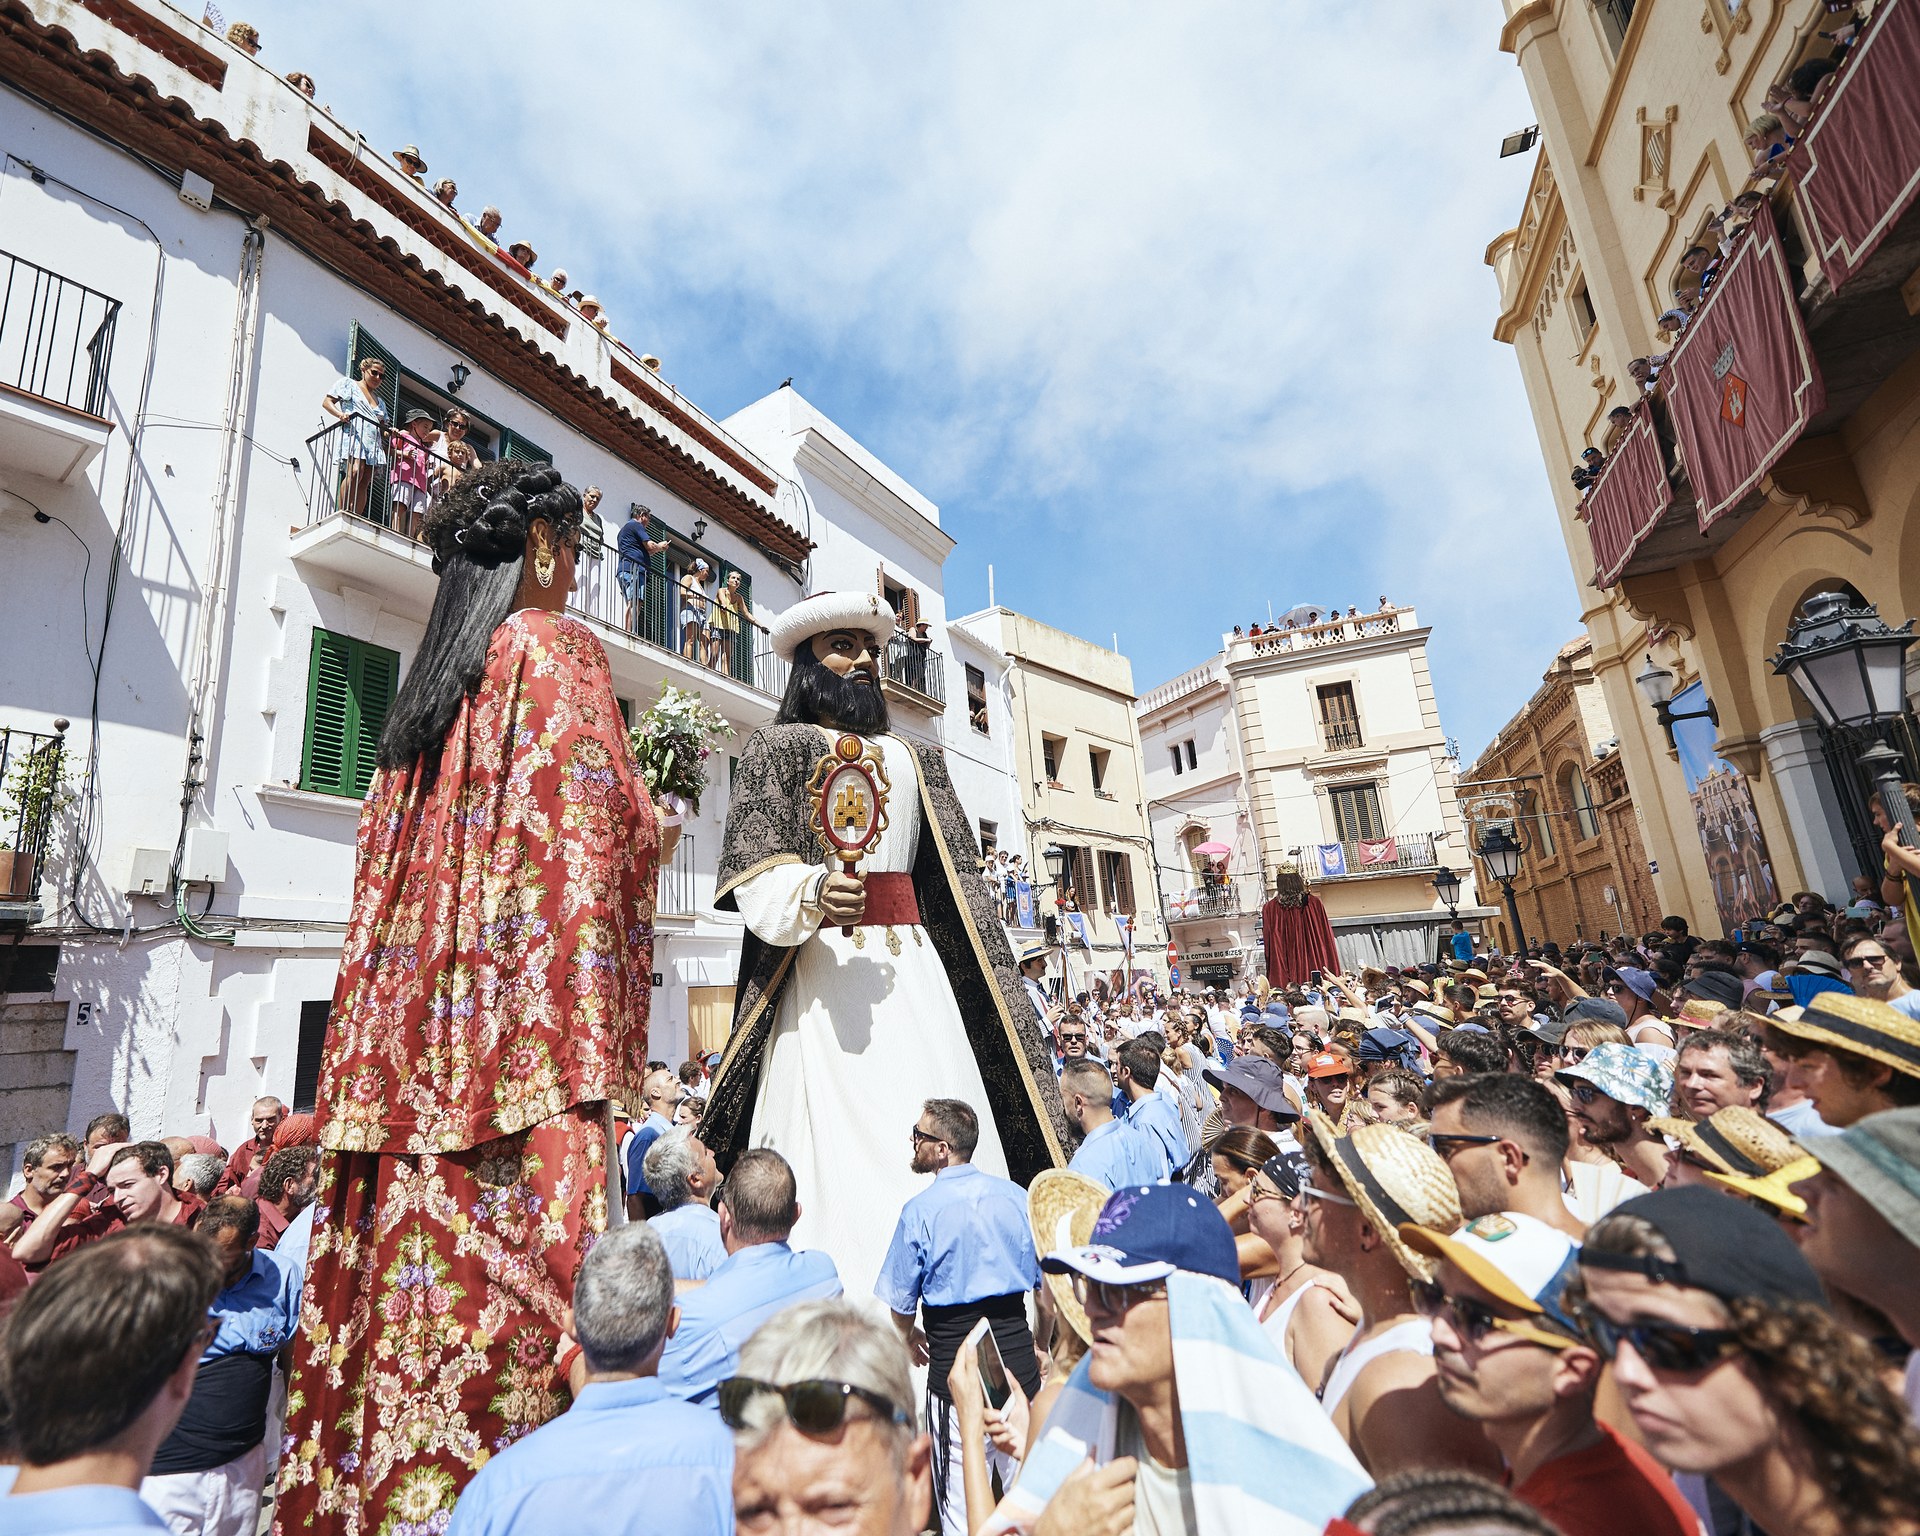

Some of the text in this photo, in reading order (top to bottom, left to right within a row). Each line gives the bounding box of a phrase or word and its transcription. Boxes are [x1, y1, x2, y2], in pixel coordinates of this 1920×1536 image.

[1191, 952, 1213, 960] COTTON
[1195, 965, 1229, 975] JANSITGES
[655, 974, 661, 985] 6
[78, 1004, 91, 1025] 5
